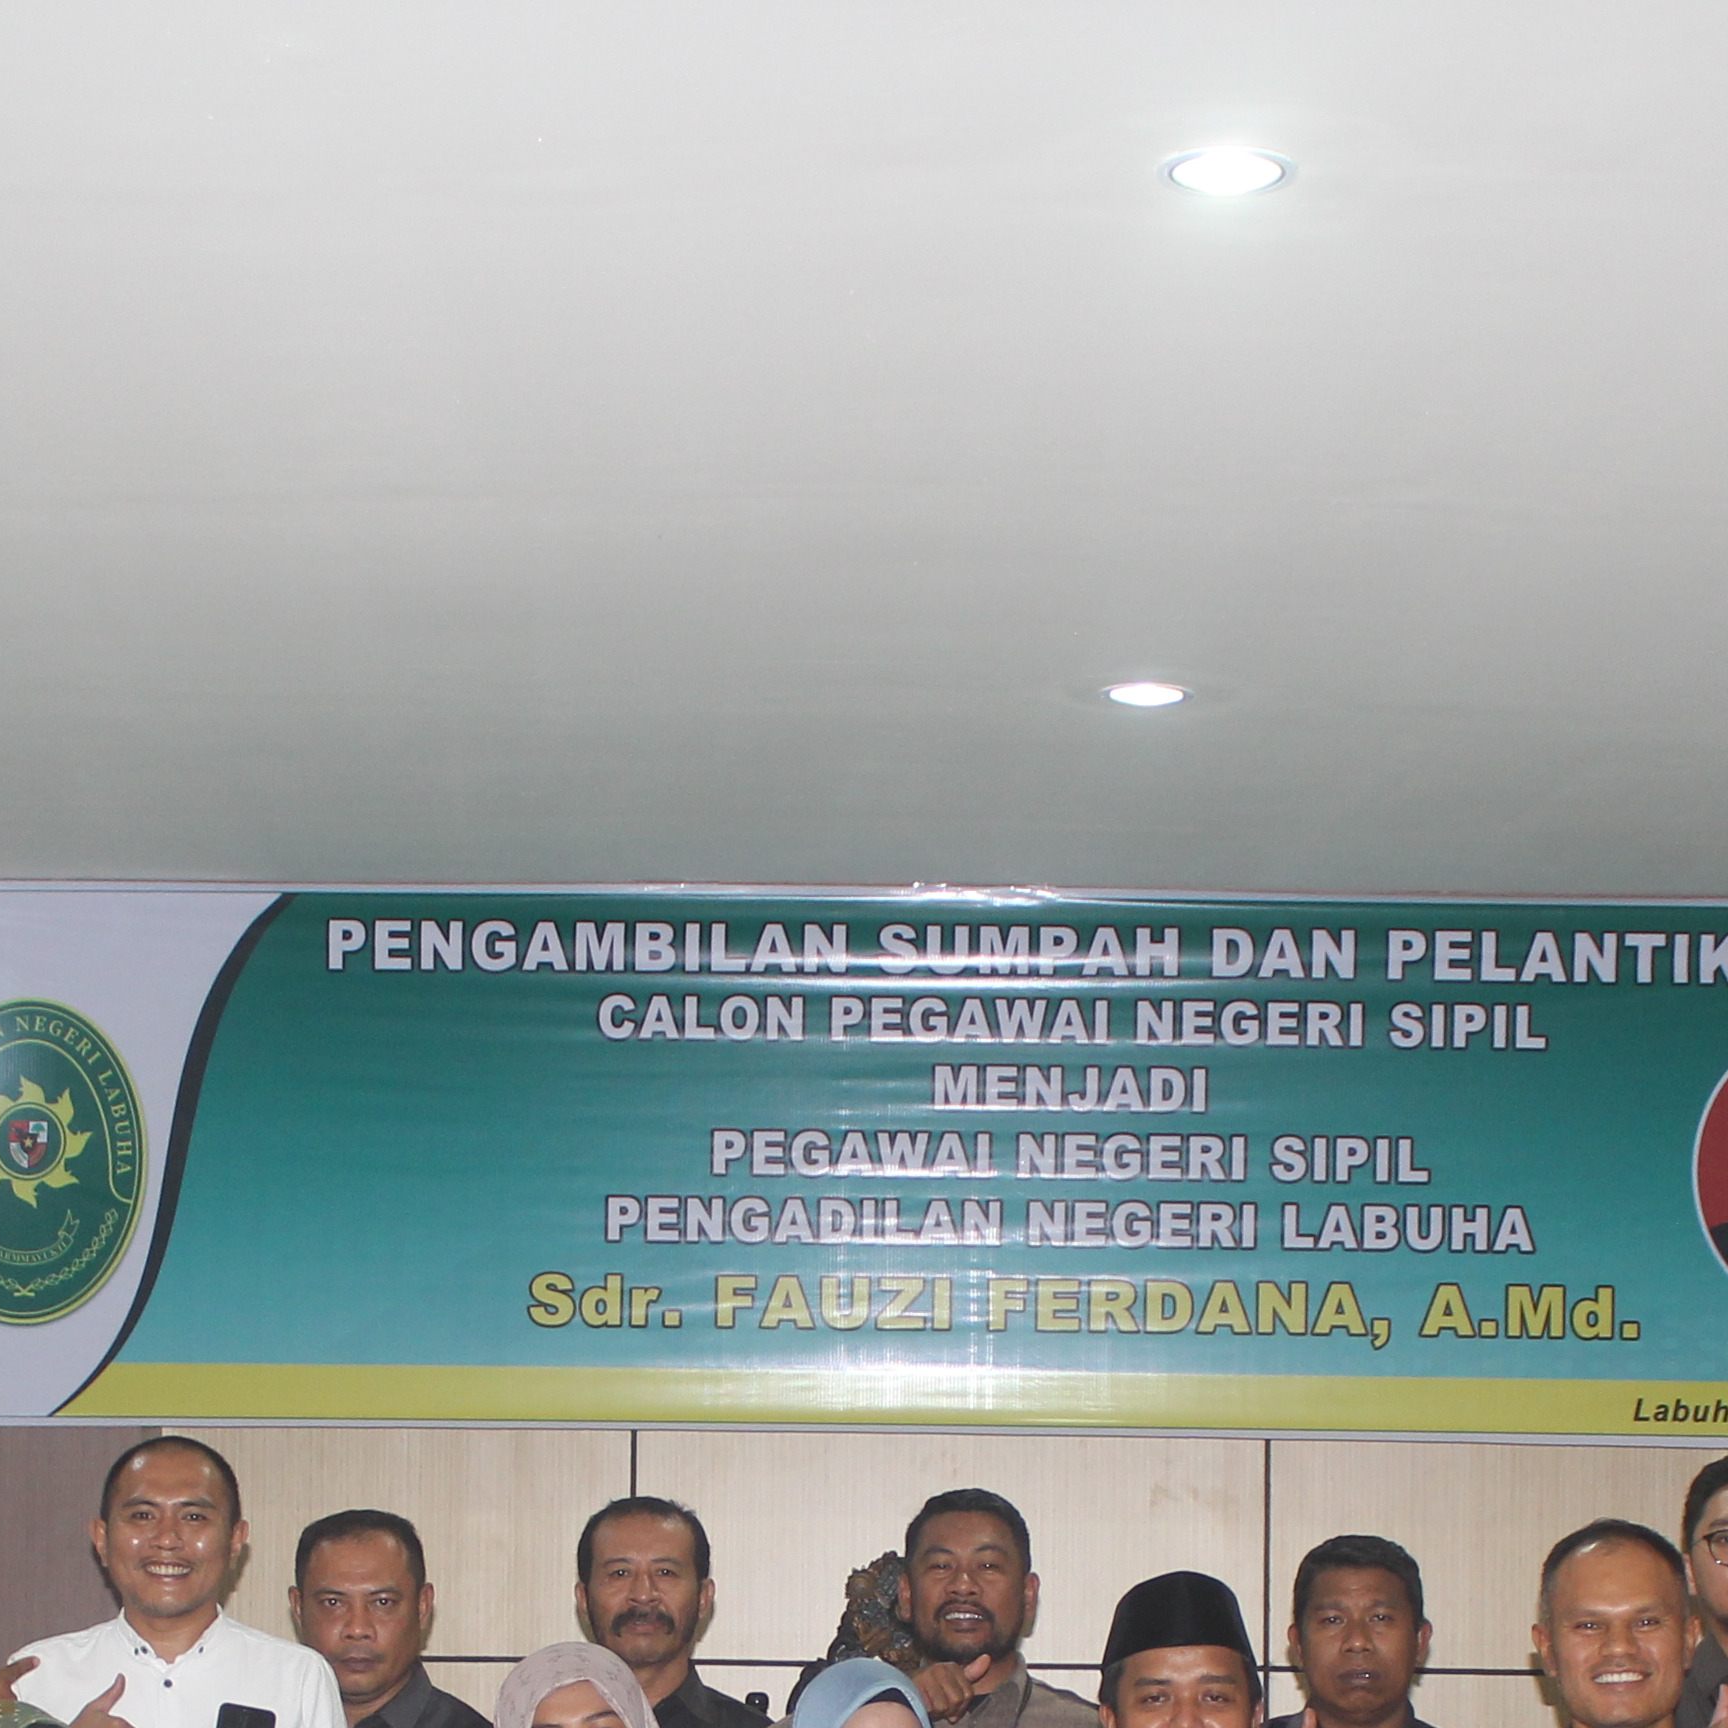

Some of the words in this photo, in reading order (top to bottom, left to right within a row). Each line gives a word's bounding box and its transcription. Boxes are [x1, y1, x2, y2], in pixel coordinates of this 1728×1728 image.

[326, 918, 849, 974] PENGAMBILAN
[877, 922, 1180, 978] SUMPAH
[1211, 928, 1356, 981] DAN
[598, 994, 804, 1041] CALON
[831, 997, 1109, 1044] PEGAWAI
[1135, 1000, 1363, 1048] NEGERI
[1389, 1004, 1547, 1051] SIPIL
[15, 1015, 102, 1065] NEGERI
[97, 1069, 133, 1175] LABUHA
[933, 1065, 1209, 1114] MENJADI
[711, 1129, 993, 1178] PEGAWAI
[1016, 1132, 1246, 1181] NEGERI
[1271, 1135, 1431, 1184] SIPIL
[605, 1196, 1003, 1246] PENGADILAN
[1028, 1200, 1256, 1250] NEGERI
[1282, 1204, 1535, 1253] LABUHA
[527, 1272, 682, 1329] Sdr.
[715, 1274, 953, 1332] FAUZI
[987, 1277, 1391, 1350] FERDANA,
[1421, 1285, 1641, 1341] A.Md.
